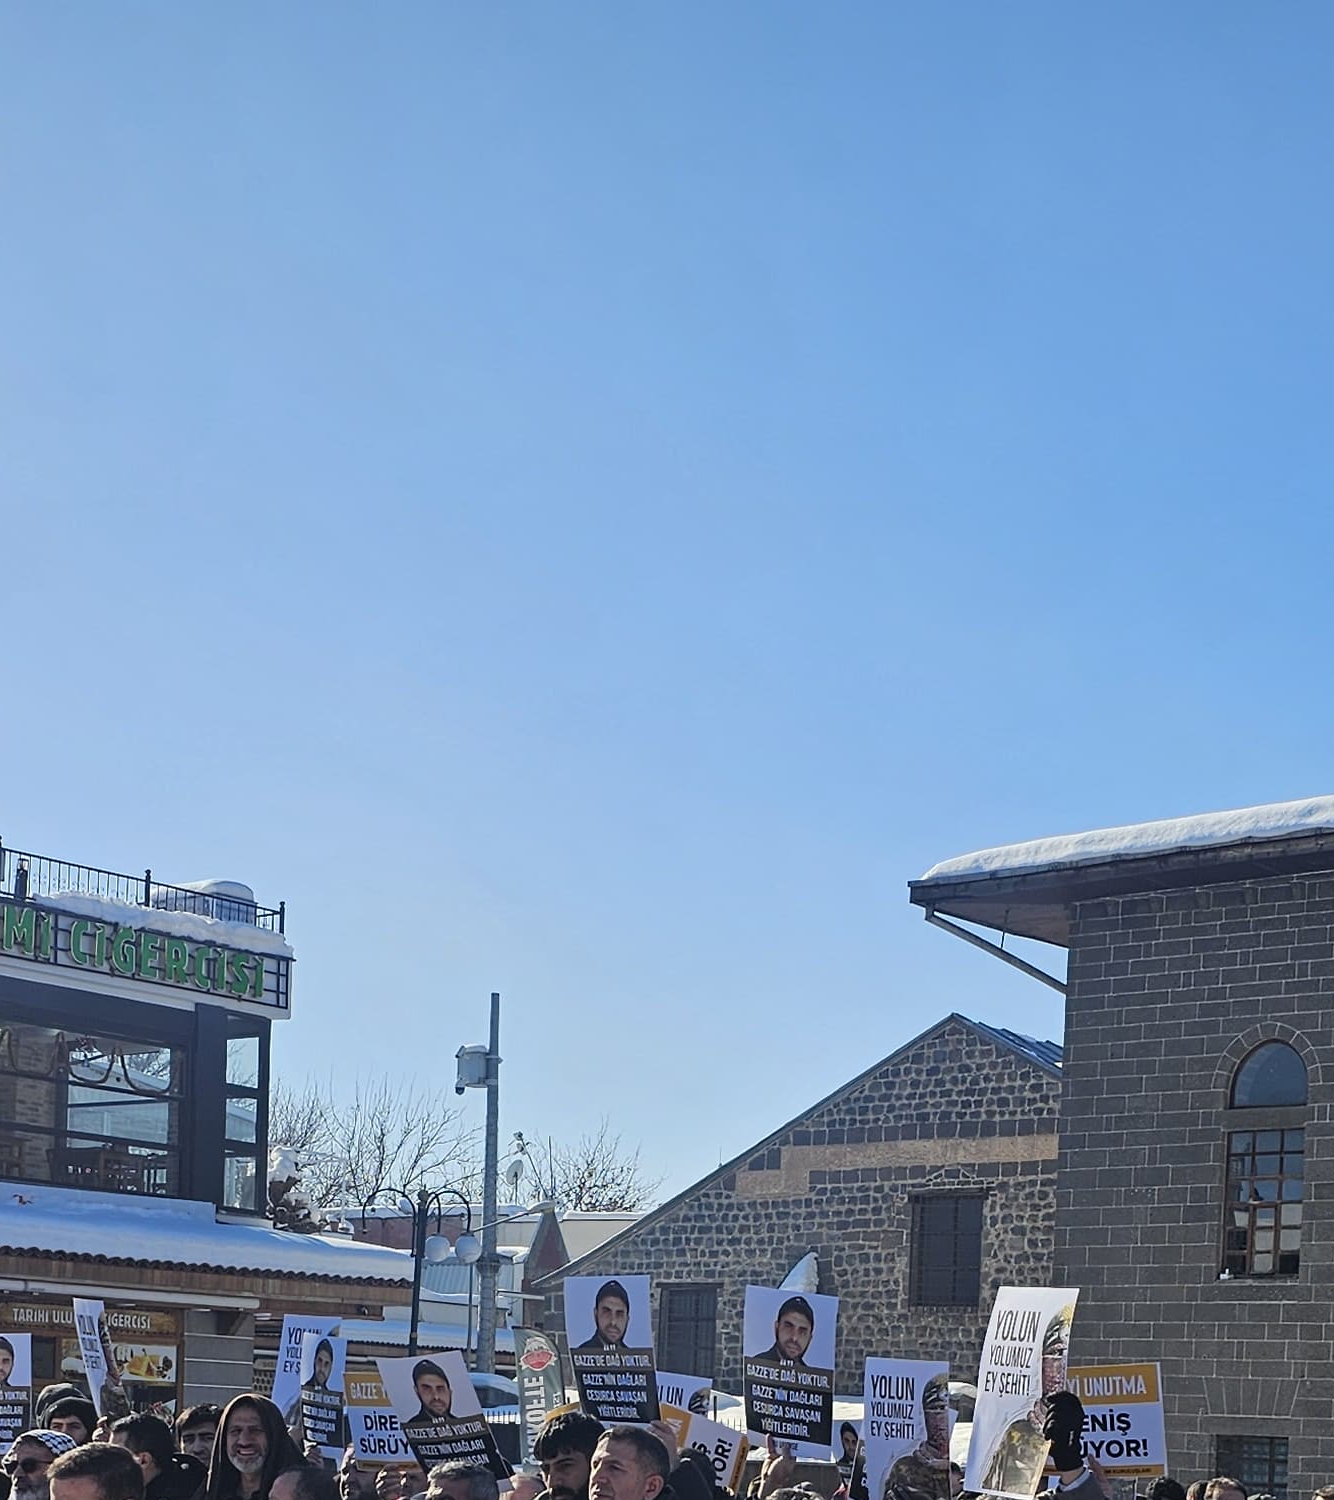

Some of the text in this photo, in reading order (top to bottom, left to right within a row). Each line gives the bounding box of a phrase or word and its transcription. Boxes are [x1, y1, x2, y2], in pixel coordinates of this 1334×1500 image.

[994, 1309, 1041, 1343] YOLUN
[606, 1353, 621, 1367] DAĞ
[989, 1344, 1034, 1369] YOLUMUZ
[780, 1368, 796, 1384] DAĞ
[798, 1372, 831, 1389] YOKTUR.
[870, 1374, 915, 1401] YOLUN
[984, 1369, 1030, 1399] EY ŞEHİT!
[1084, 1374, 1147, 1397] UNUTMA
[753, 1401, 822, 1424] CESURCA SAVAŞAN
[870, 1400, 914, 1420] YOLUMUZ
[870, 1420, 915, 1441] EY ŞEHİT!
[359, 1434, 411, 1455] SÜRÜY
